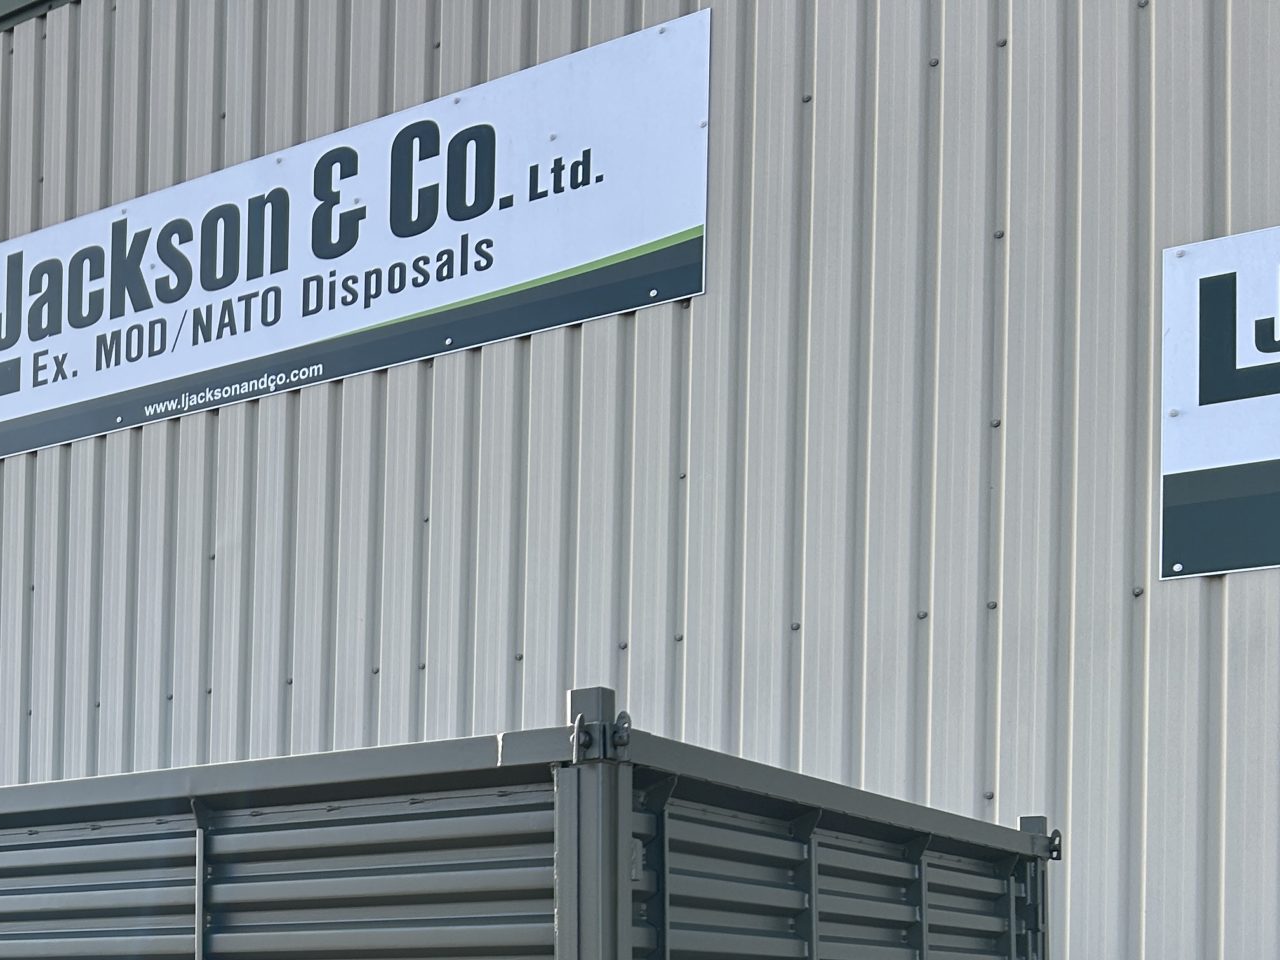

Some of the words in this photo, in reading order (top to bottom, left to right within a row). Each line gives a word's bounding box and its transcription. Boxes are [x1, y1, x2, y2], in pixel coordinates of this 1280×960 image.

[312, 146, 366, 259] &
[389, 119, 514, 238] Co.
[529, 148, 604, 201] Ltd.
[32, 349, 78, 388] Ex.
[95, 286, 282, 371] MOD/NATO
[302, 233, 494, 317] Disposals
[144, 363, 324, 416] www.ljacksonandco.com
